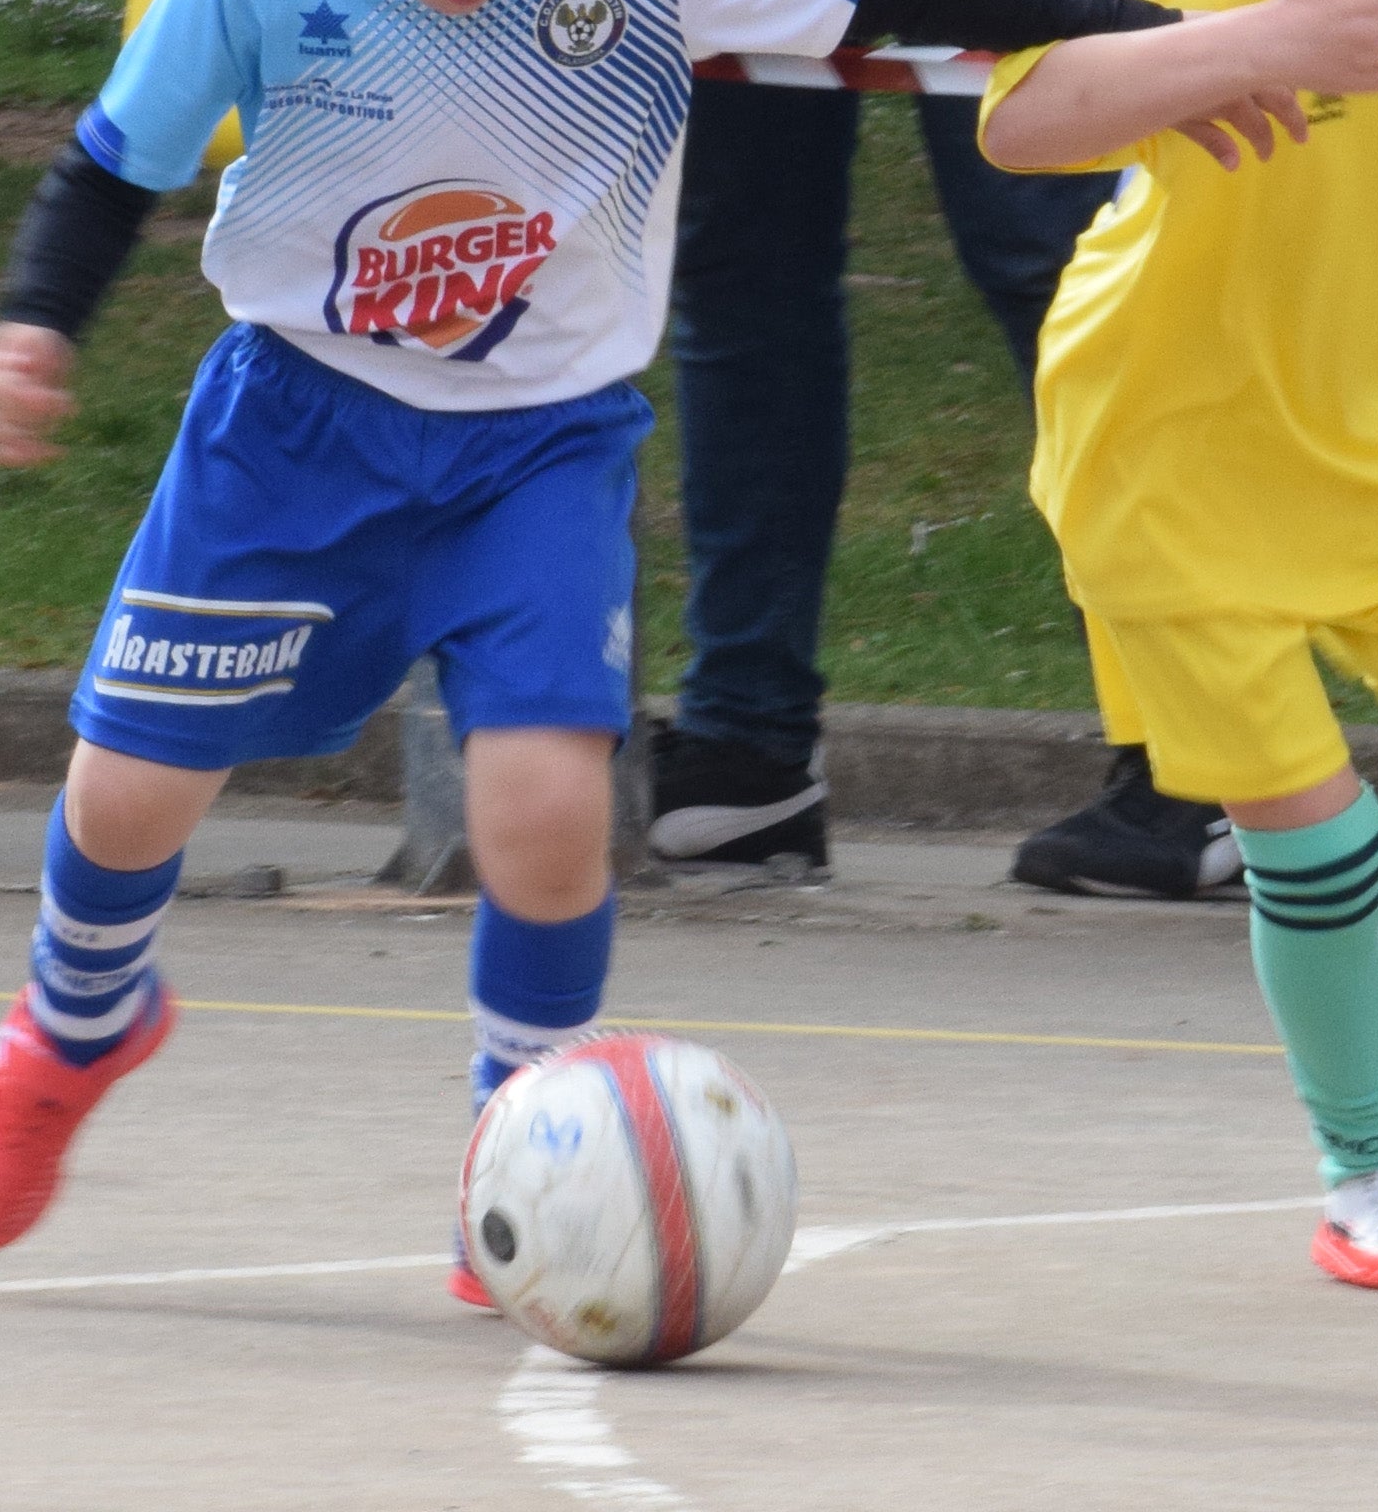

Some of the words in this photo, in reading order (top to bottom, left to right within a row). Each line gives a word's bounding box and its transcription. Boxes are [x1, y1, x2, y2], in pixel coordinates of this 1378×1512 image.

[299, 43, 352, 58] luanvi
[315, 97, 394, 122] DEPORTIVOS
[351, 211, 557, 288] BURGER
